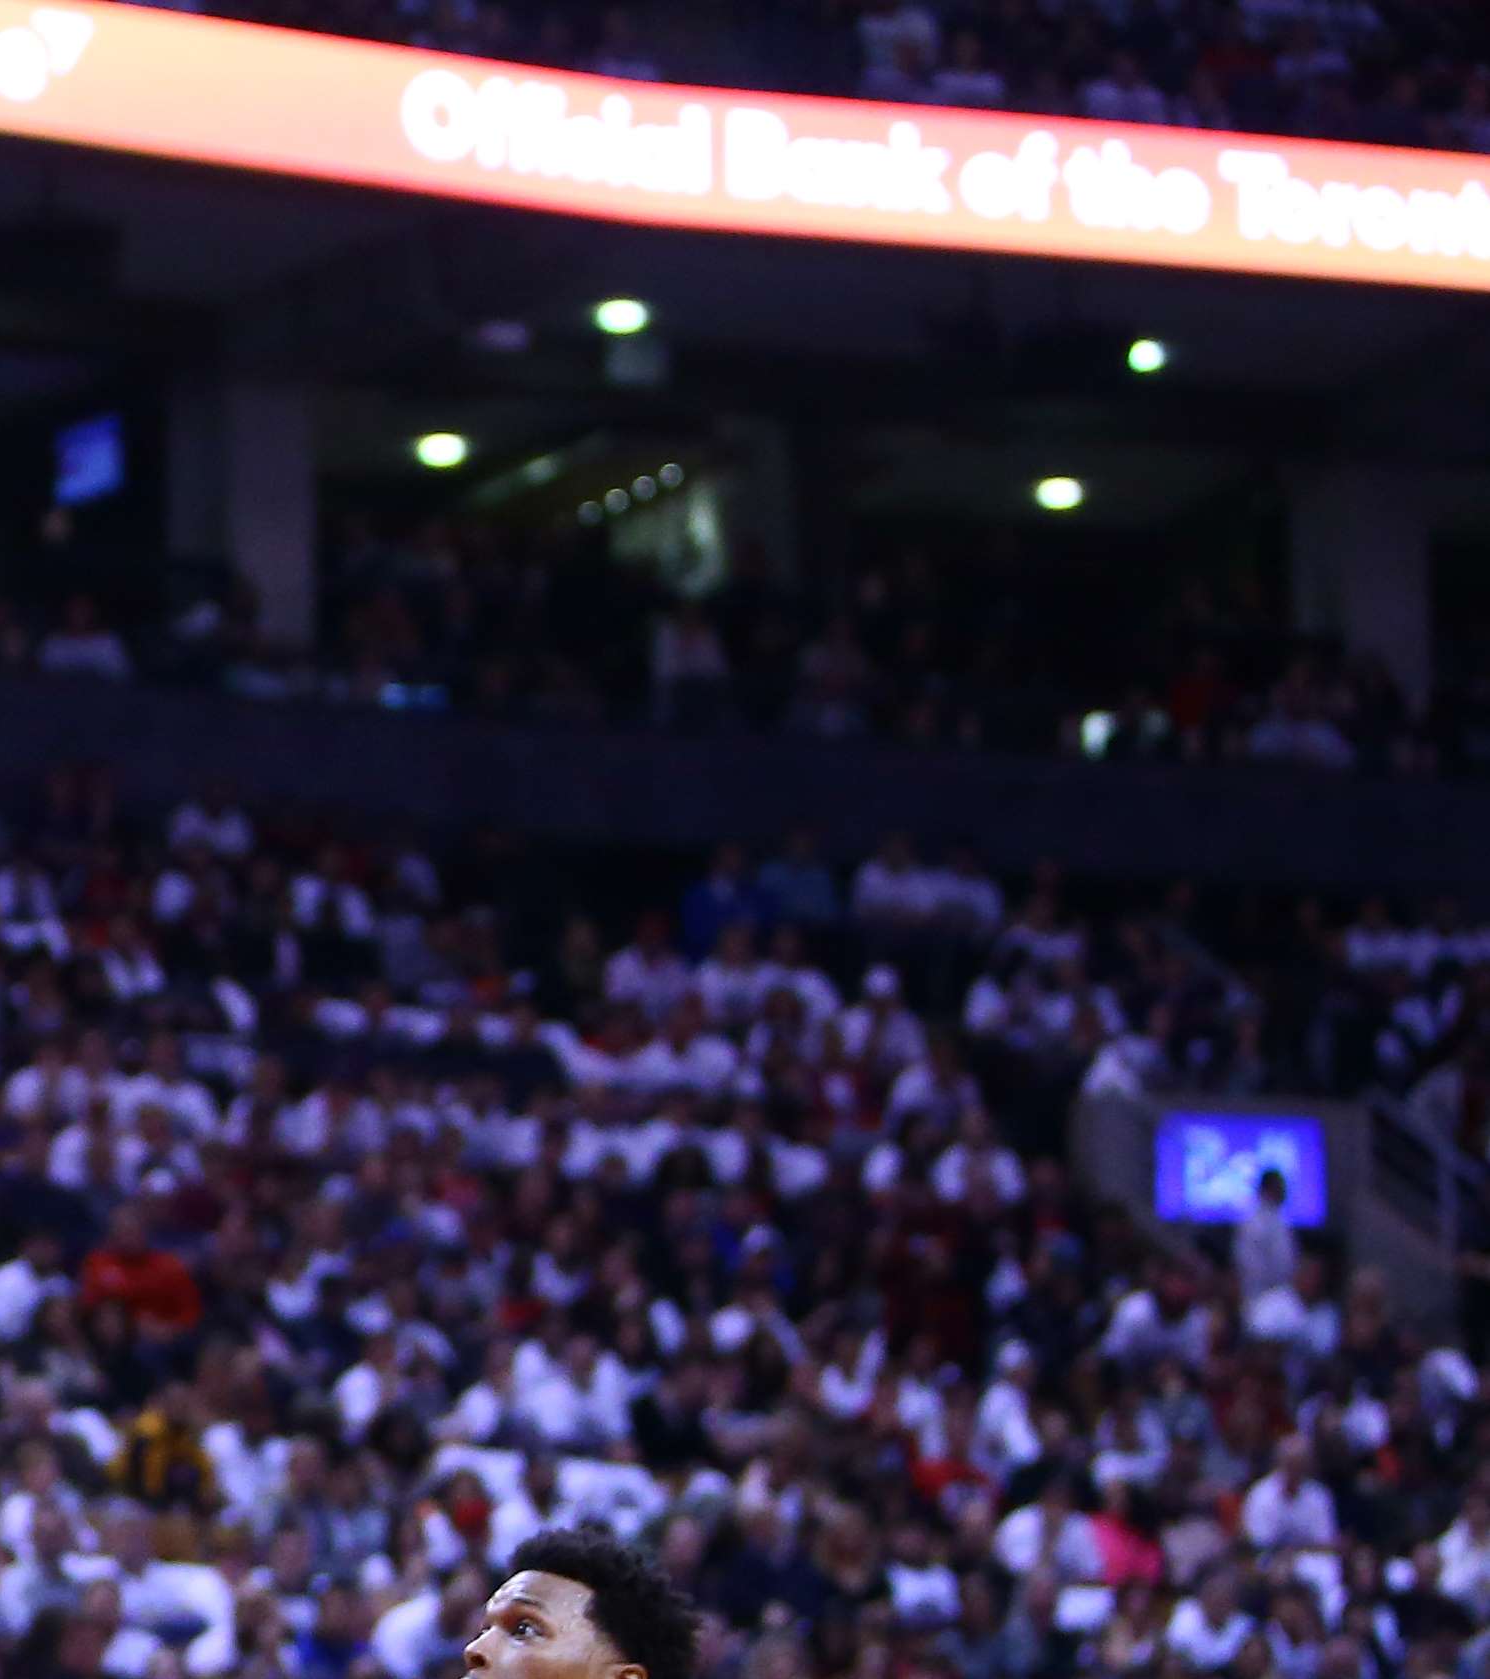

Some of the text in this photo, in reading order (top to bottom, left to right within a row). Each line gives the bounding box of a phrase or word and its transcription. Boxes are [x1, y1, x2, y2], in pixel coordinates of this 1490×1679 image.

[725, 107, 951, 213] Bank
[959, 130, 1058, 221] of
[1062, 138, 1210, 235] the
